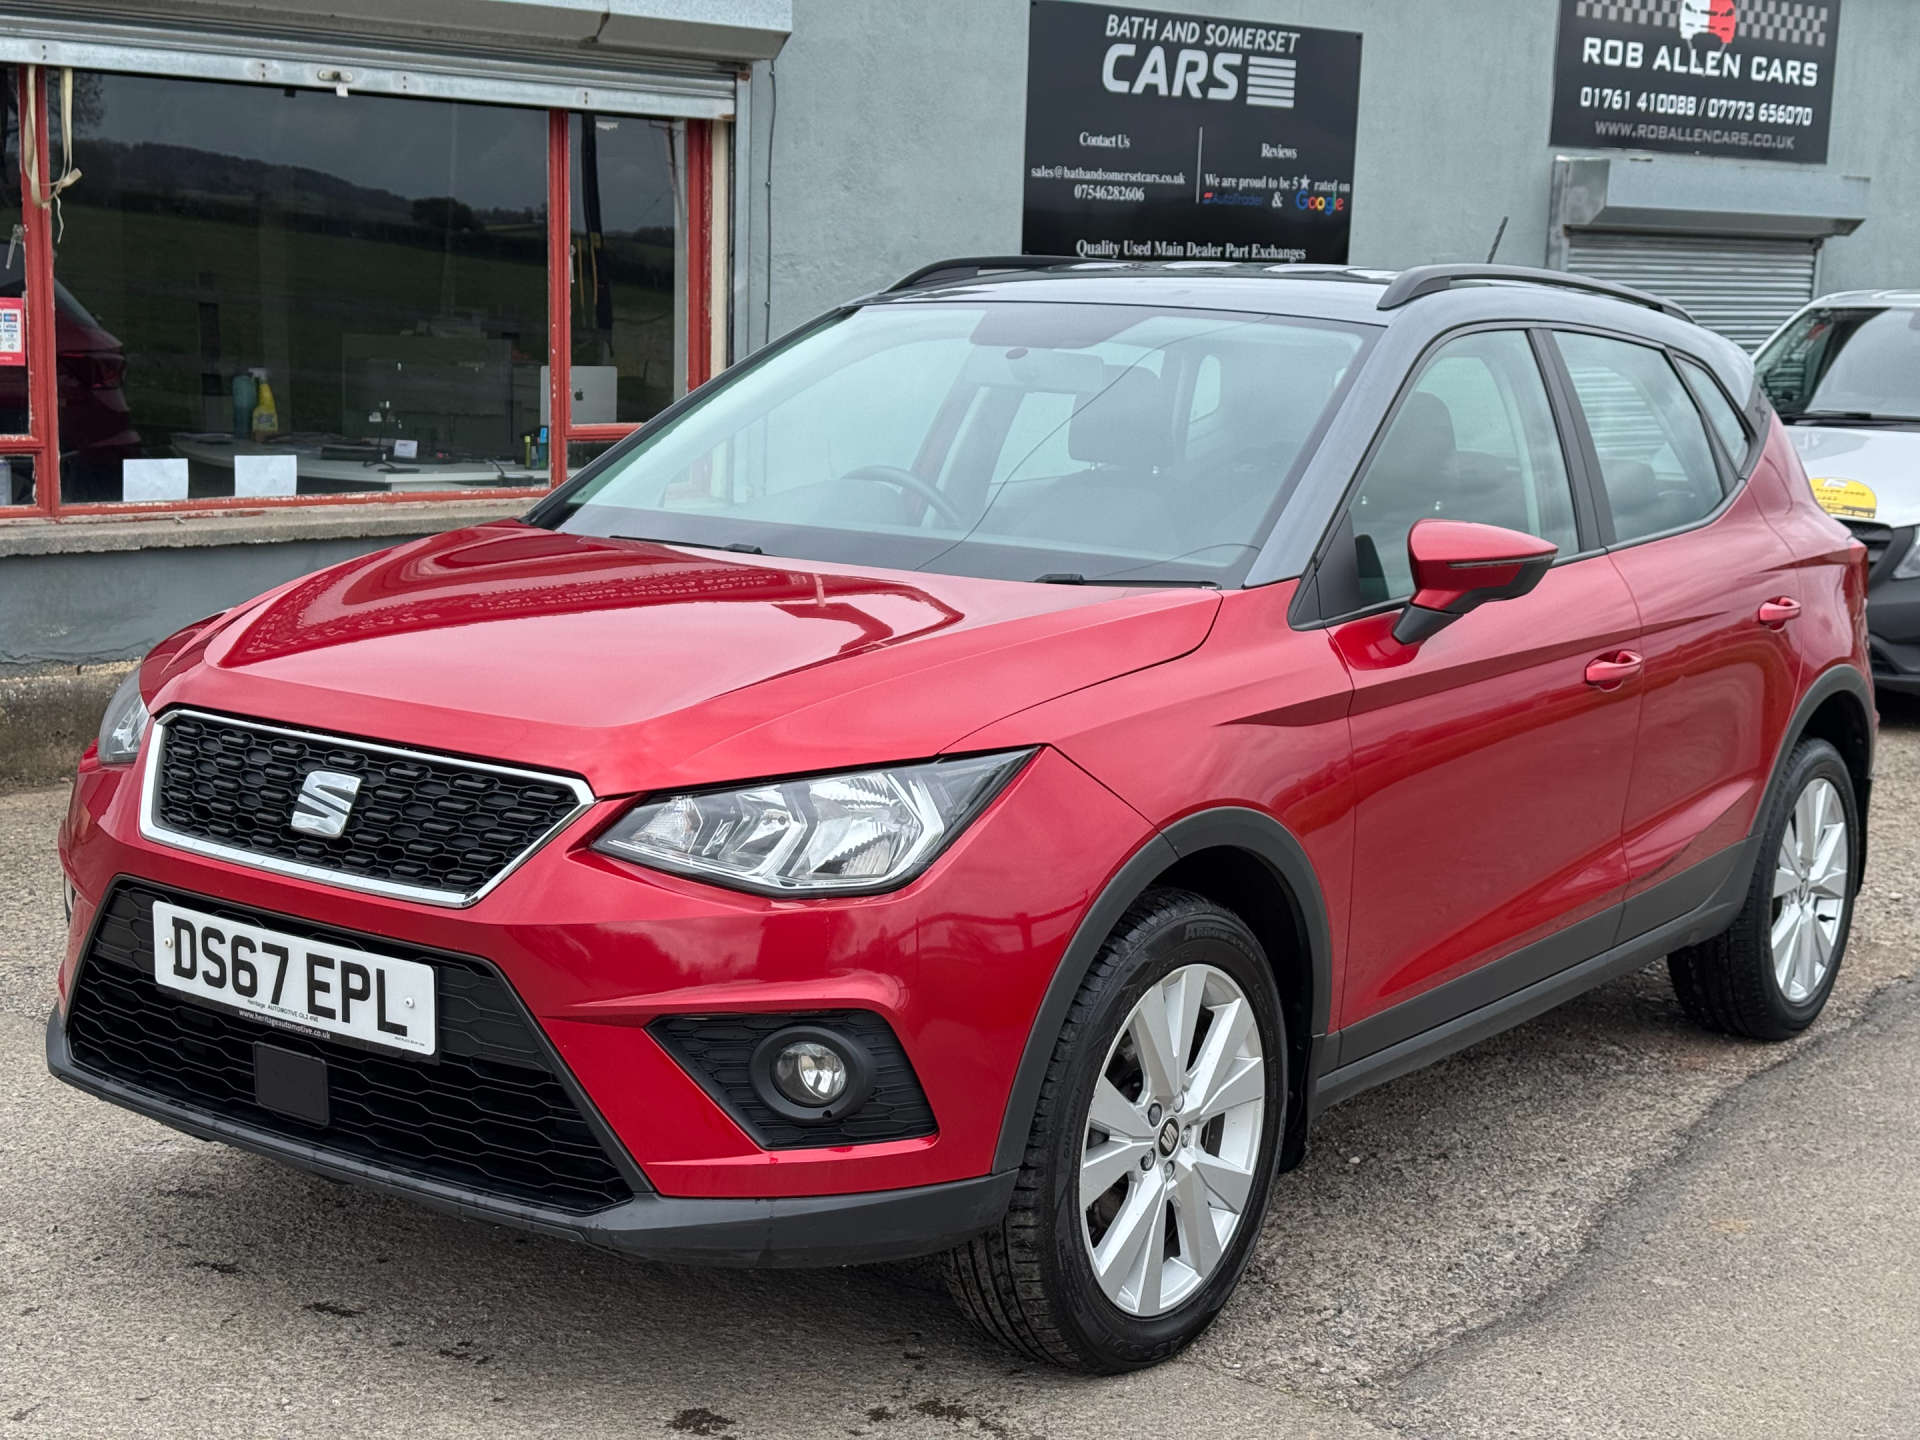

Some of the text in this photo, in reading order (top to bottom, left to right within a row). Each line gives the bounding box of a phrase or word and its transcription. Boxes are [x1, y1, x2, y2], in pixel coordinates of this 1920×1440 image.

[1105, 14, 1300, 54] BATH AND SOMERSET
[1102, 43, 1243, 101] CARS
[1582, 37, 1818, 87] ROB ALLEN CARS
[1580, 86, 1631, 110] 01761
[1636, 91, 1696, 117] 410088
[1707, 98, 1755, 121] 07773
[1758, 103, 1812, 126] 656070
[1079, 131, 1130, 149] Contact Us
[1594, 120, 1795, 149] WWW.ROBALLENCARS.CO.UK
[1261, 143, 1298, 160] Reviews
[1031, 165, 1185, 184] sales@bathandsomersetcars.co.uk
[1204, 173, 1350, 192] We are proud to be 5 rated on
[1074, 184, 1145, 202] 07546282606
[1271, 191, 1283, 208] &
[1295, 189, 1345, 216] Google
[1076, 239, 1307, 263] Quality Used Main Dealer Part Exchanges
[171, 915, 408, 1038] DS67 EPL
